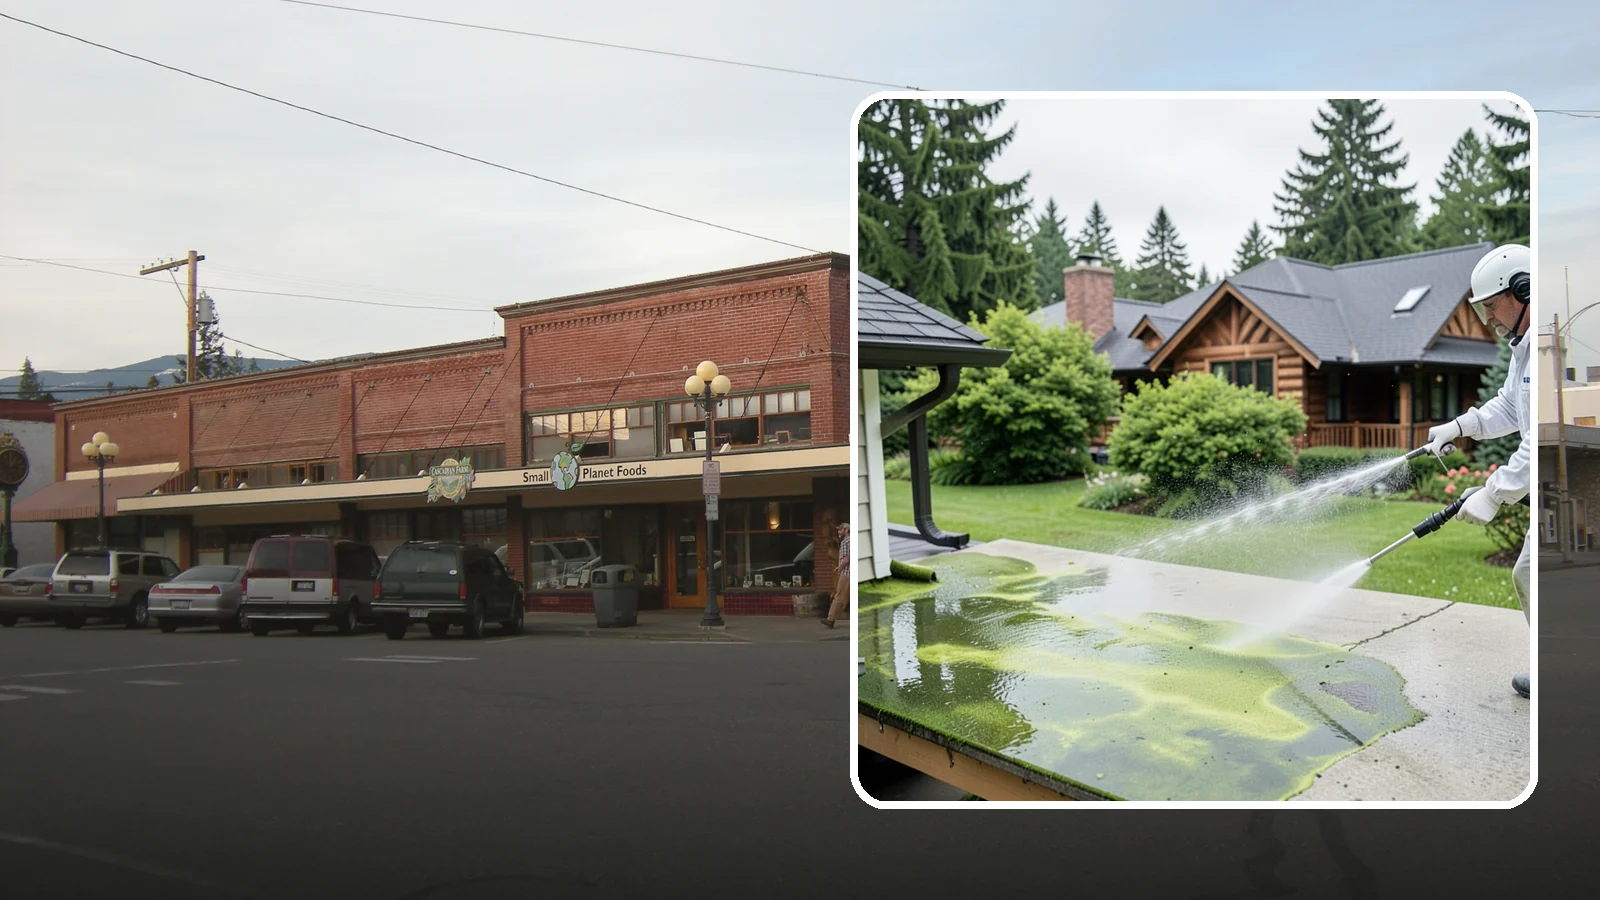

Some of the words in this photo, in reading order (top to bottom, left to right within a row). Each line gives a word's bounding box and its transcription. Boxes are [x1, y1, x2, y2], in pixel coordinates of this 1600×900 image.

[523, 471, 549, 483] Small
[583, 467, 614, 479] Planet
[616, 464, 647, 477] Foods
